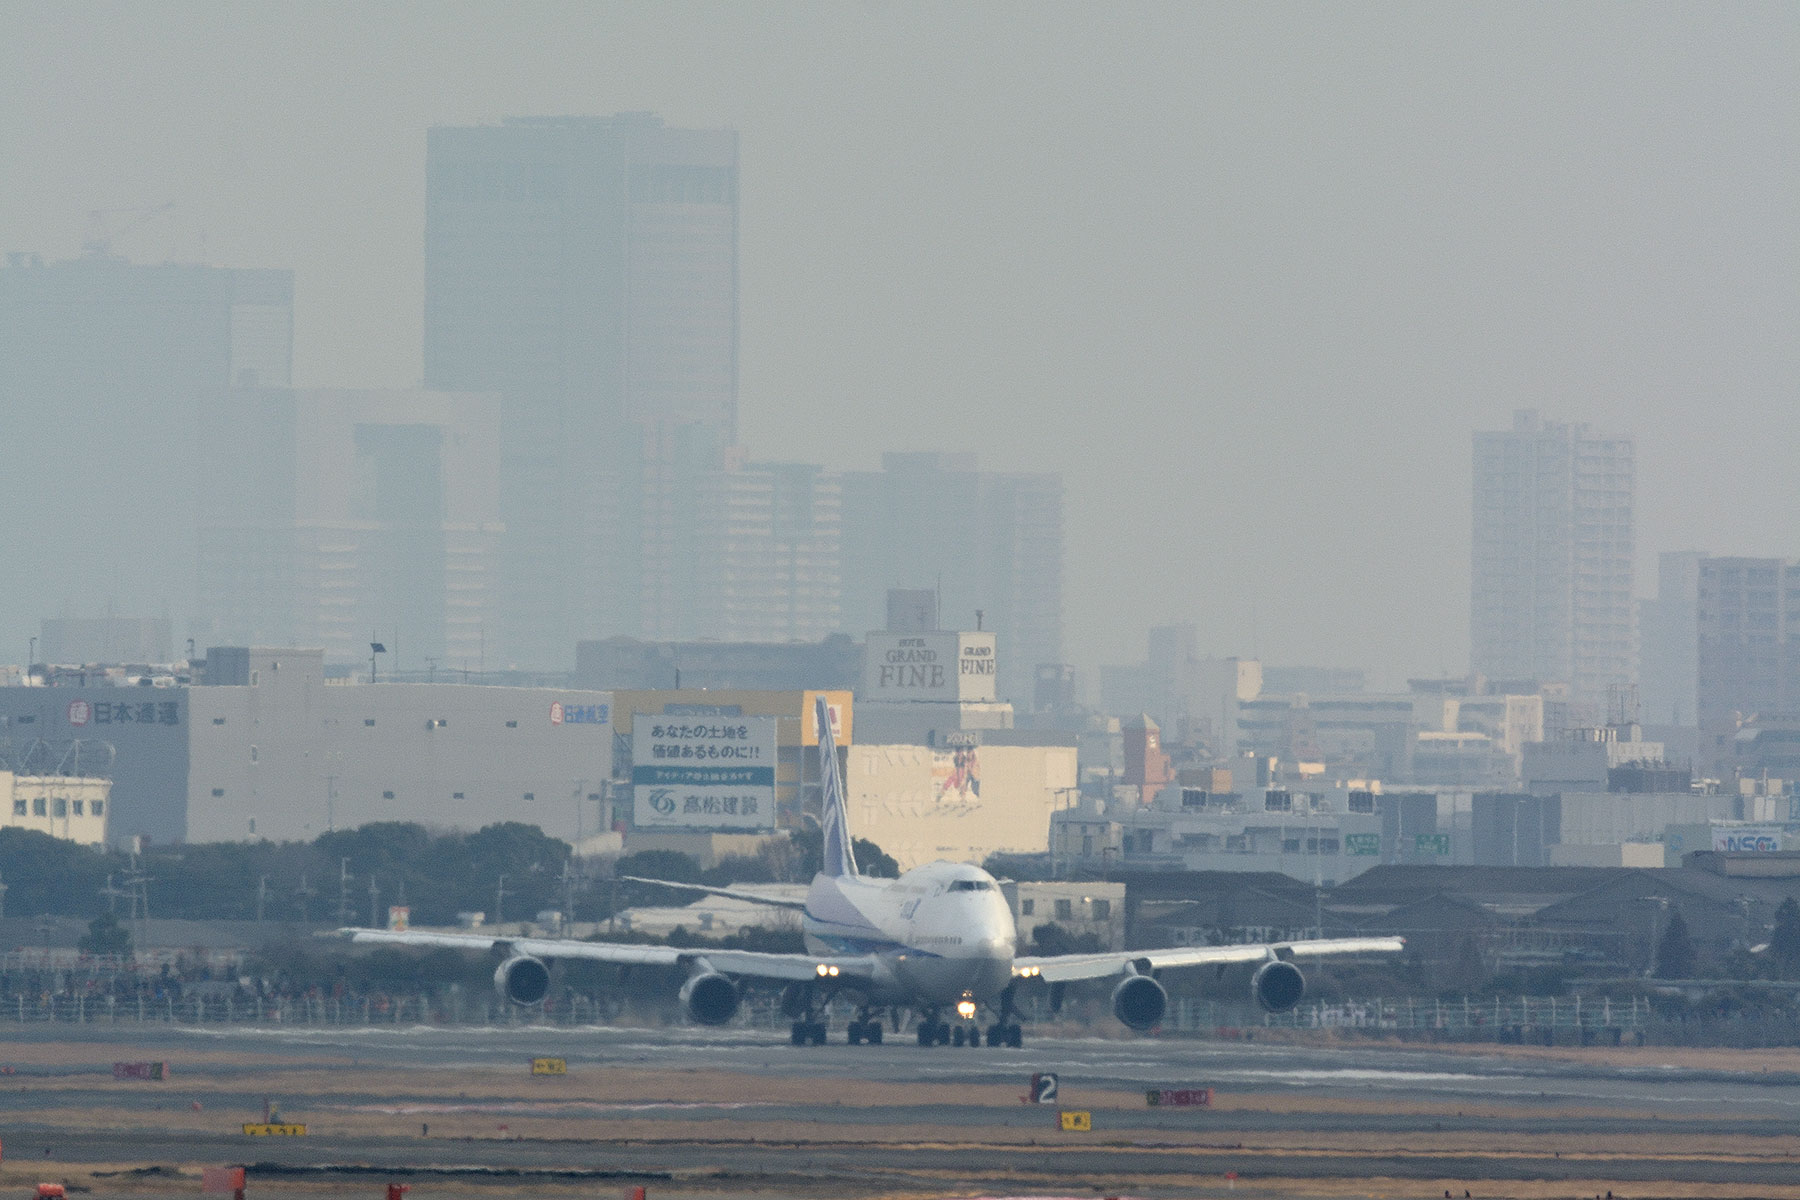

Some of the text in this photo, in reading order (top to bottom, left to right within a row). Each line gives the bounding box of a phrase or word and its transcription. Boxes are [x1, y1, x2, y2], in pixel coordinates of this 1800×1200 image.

[885, 650, 937, 663] GRAND
[964, 647, 991, 656] GRAND
[960, 659, 994, 674] FINE
[880, 665, 945, 688] FINE
[651, 725, 748, 739] あなたの土地を
[1039, 1075, 1056, 1104] 2
